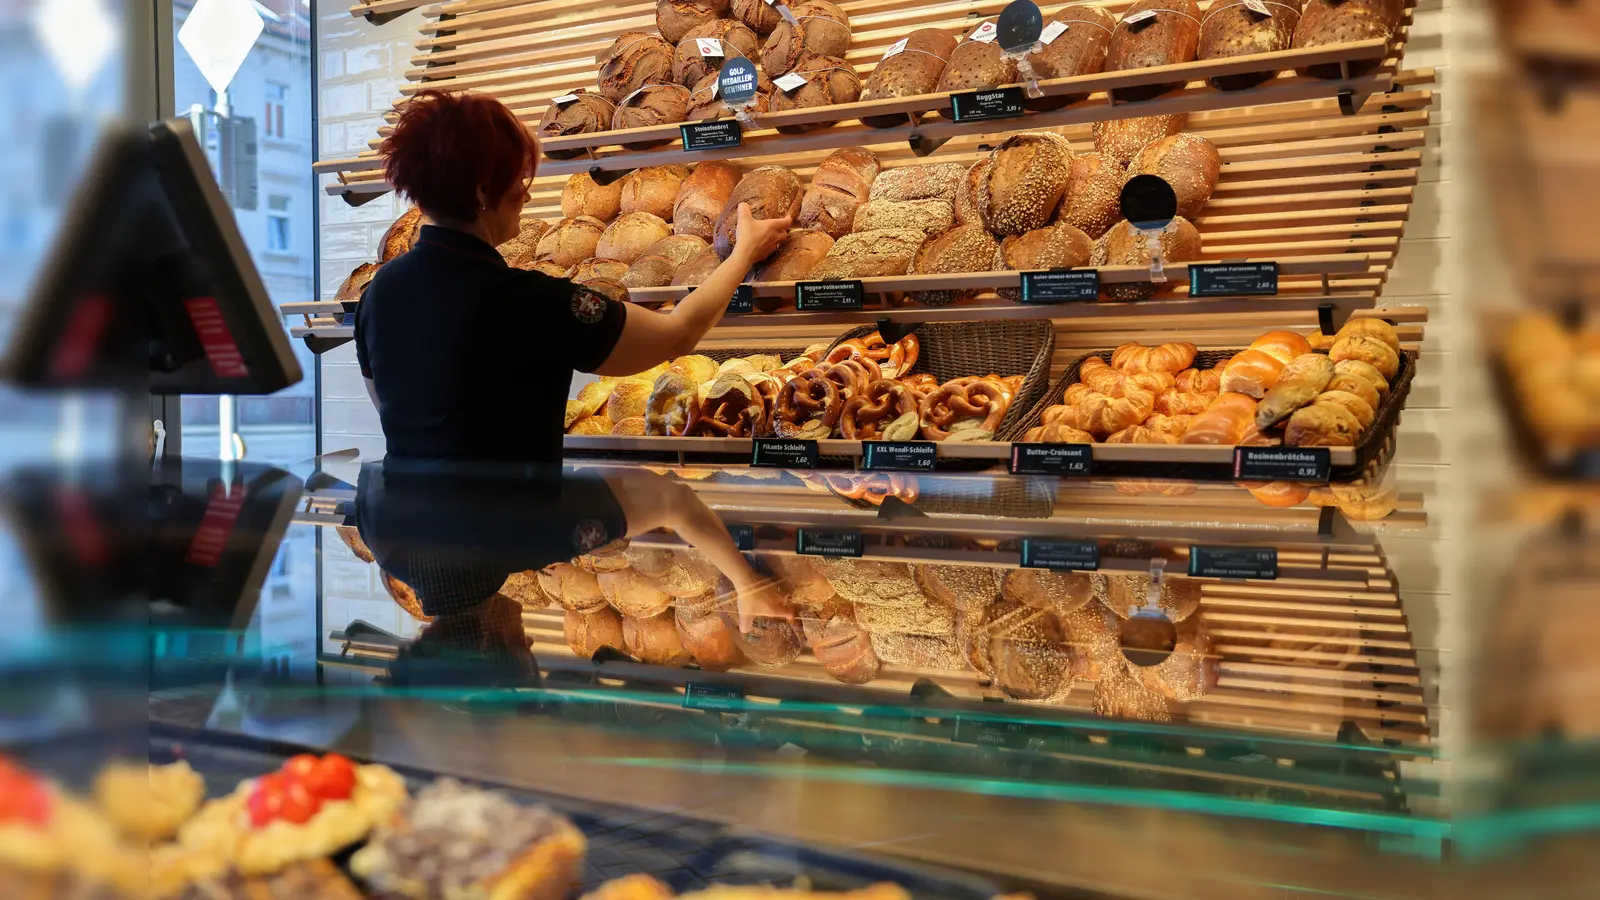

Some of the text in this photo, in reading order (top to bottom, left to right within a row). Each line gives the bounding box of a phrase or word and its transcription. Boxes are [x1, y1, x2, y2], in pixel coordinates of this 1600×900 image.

[729, 67, 746, 76] GOLD-
[722, 74, 754, 86] MEDAILLEN-
[724, 82, 753, 94] GEWINNER
[976, 93, 1005, 101] RoggStar
[694, 124, 729, 132] Steinofenbrot
[888, 446, 934, 454] Wendl-Schleife
[1026, 448, 1082, 456] Butter-Croissant
[1248, 452, 1315, 461] Rosinenbrötchen
[917, 459, 931, 467] 1,60
[1069, 462, 1084, 470] 1,65
[1298, 468, 1316, 476] 0,95
